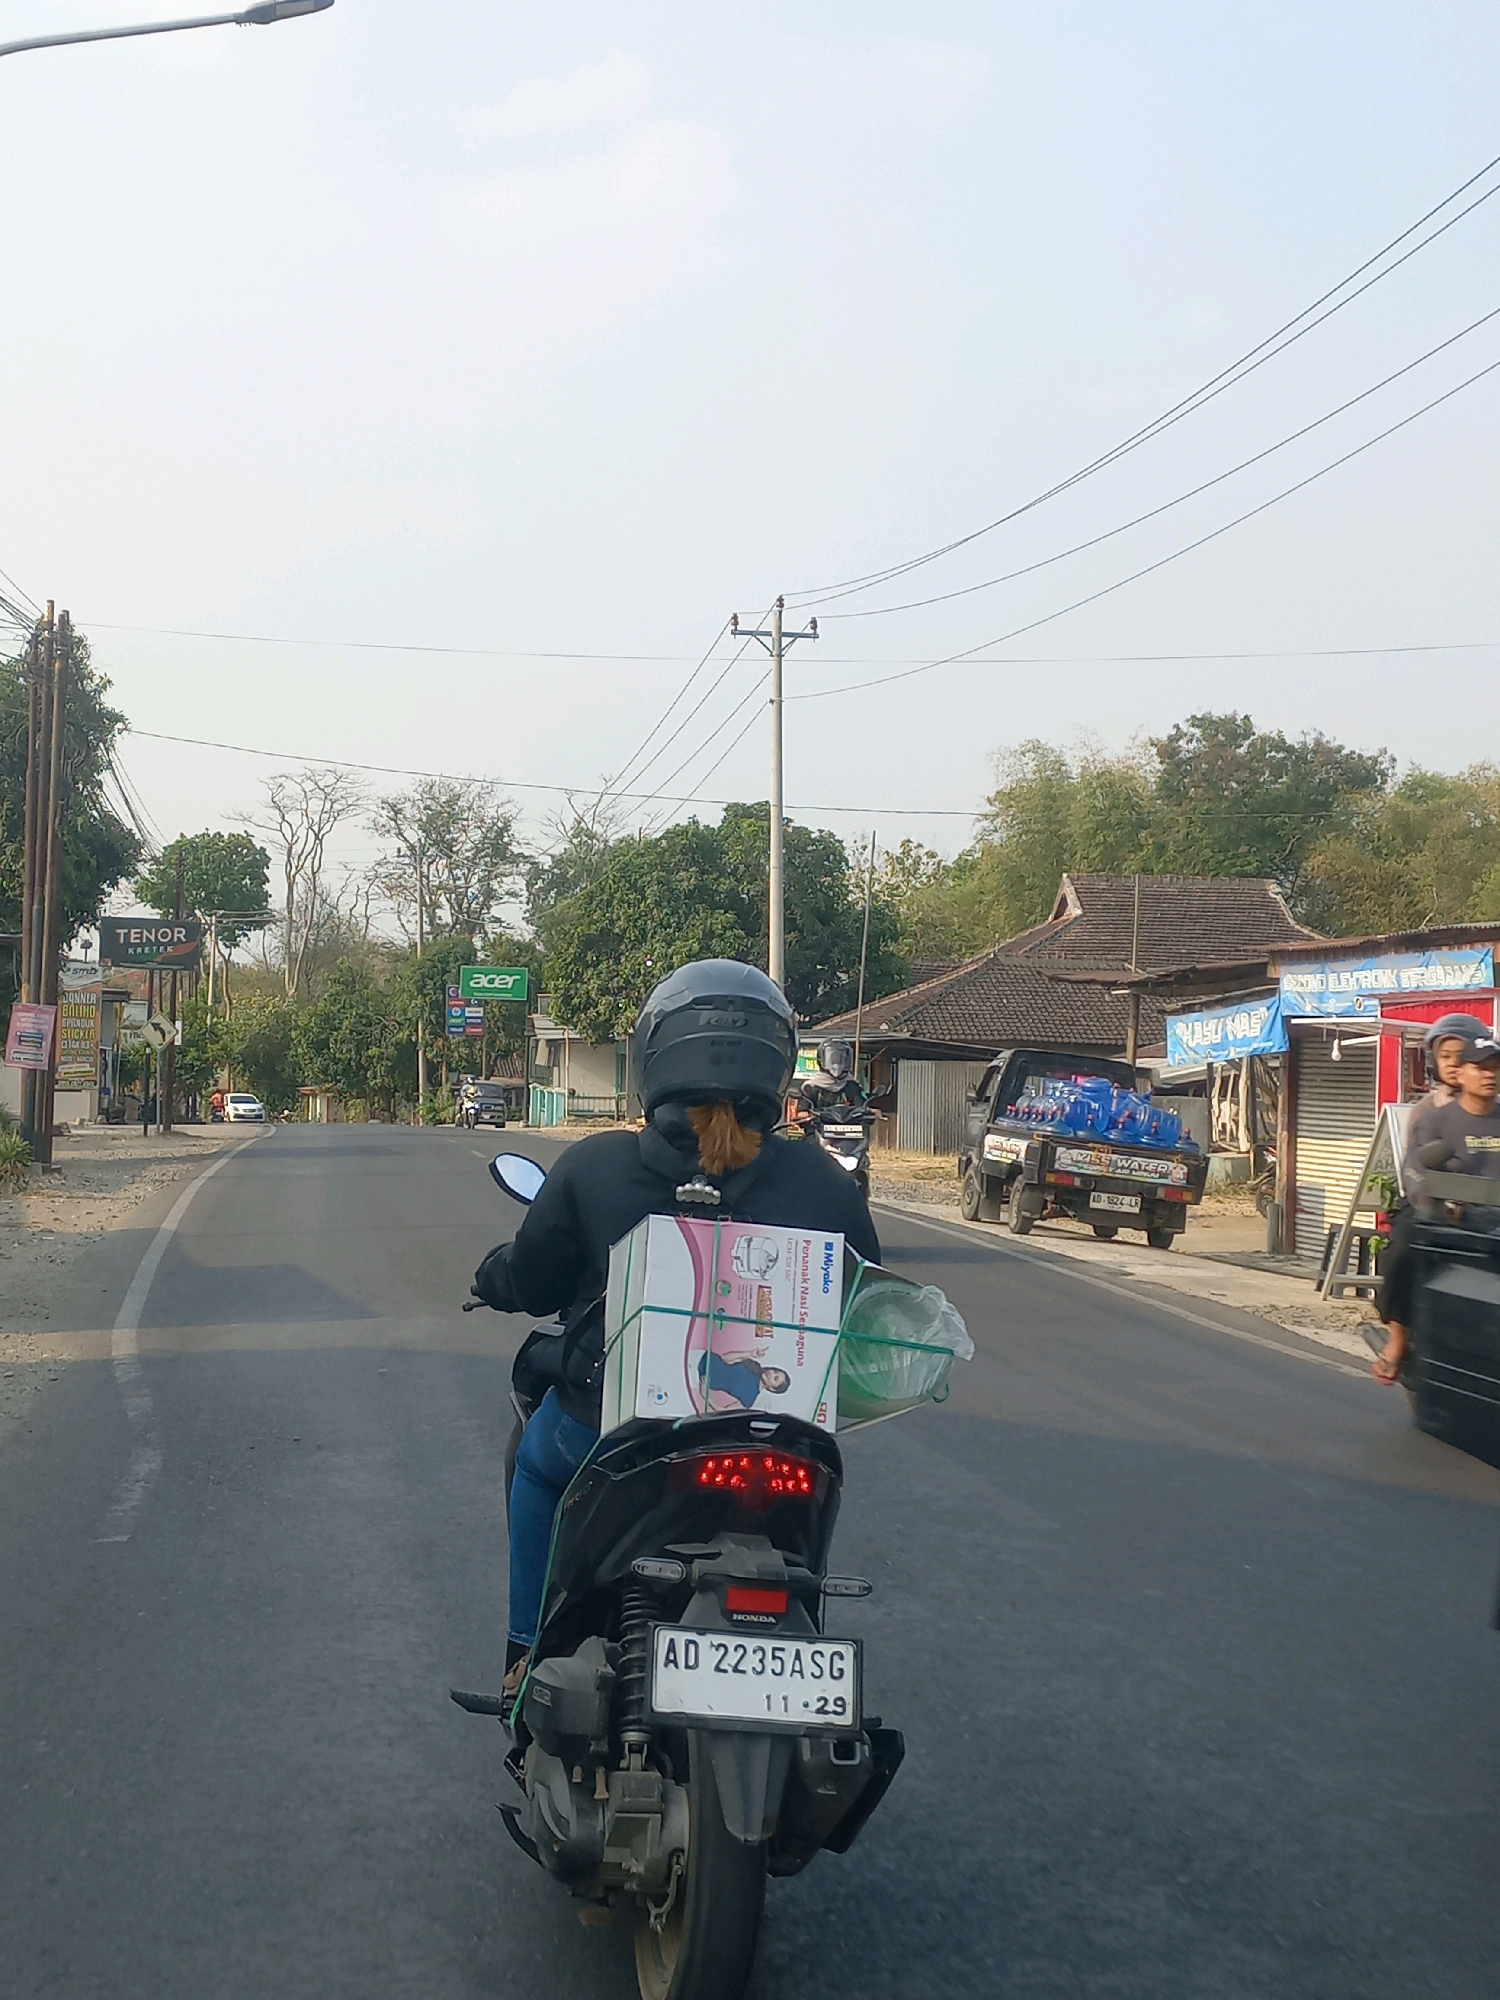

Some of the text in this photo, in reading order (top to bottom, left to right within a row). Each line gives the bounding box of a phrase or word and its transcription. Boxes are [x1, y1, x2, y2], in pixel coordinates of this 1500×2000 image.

[115, 927, 187, 944] TENOR
[127, 945, 175, 955] KRETEK
[469, 973, 522, 989] acer
[61, 1028, 95, 1040] STICKER
[1076, 1151, 1113, 1166] KISS
[1116, 1158, 1170, 1173] WATER
[800, 1239, 812, 1284] Penanak
[821, 1252, 834, 1294] Miyako
[799, 1286, 809, 1309] Nasi
[732, 1613, 777, 1623] HONDA
[664, 1637, 700, 1670] AD
